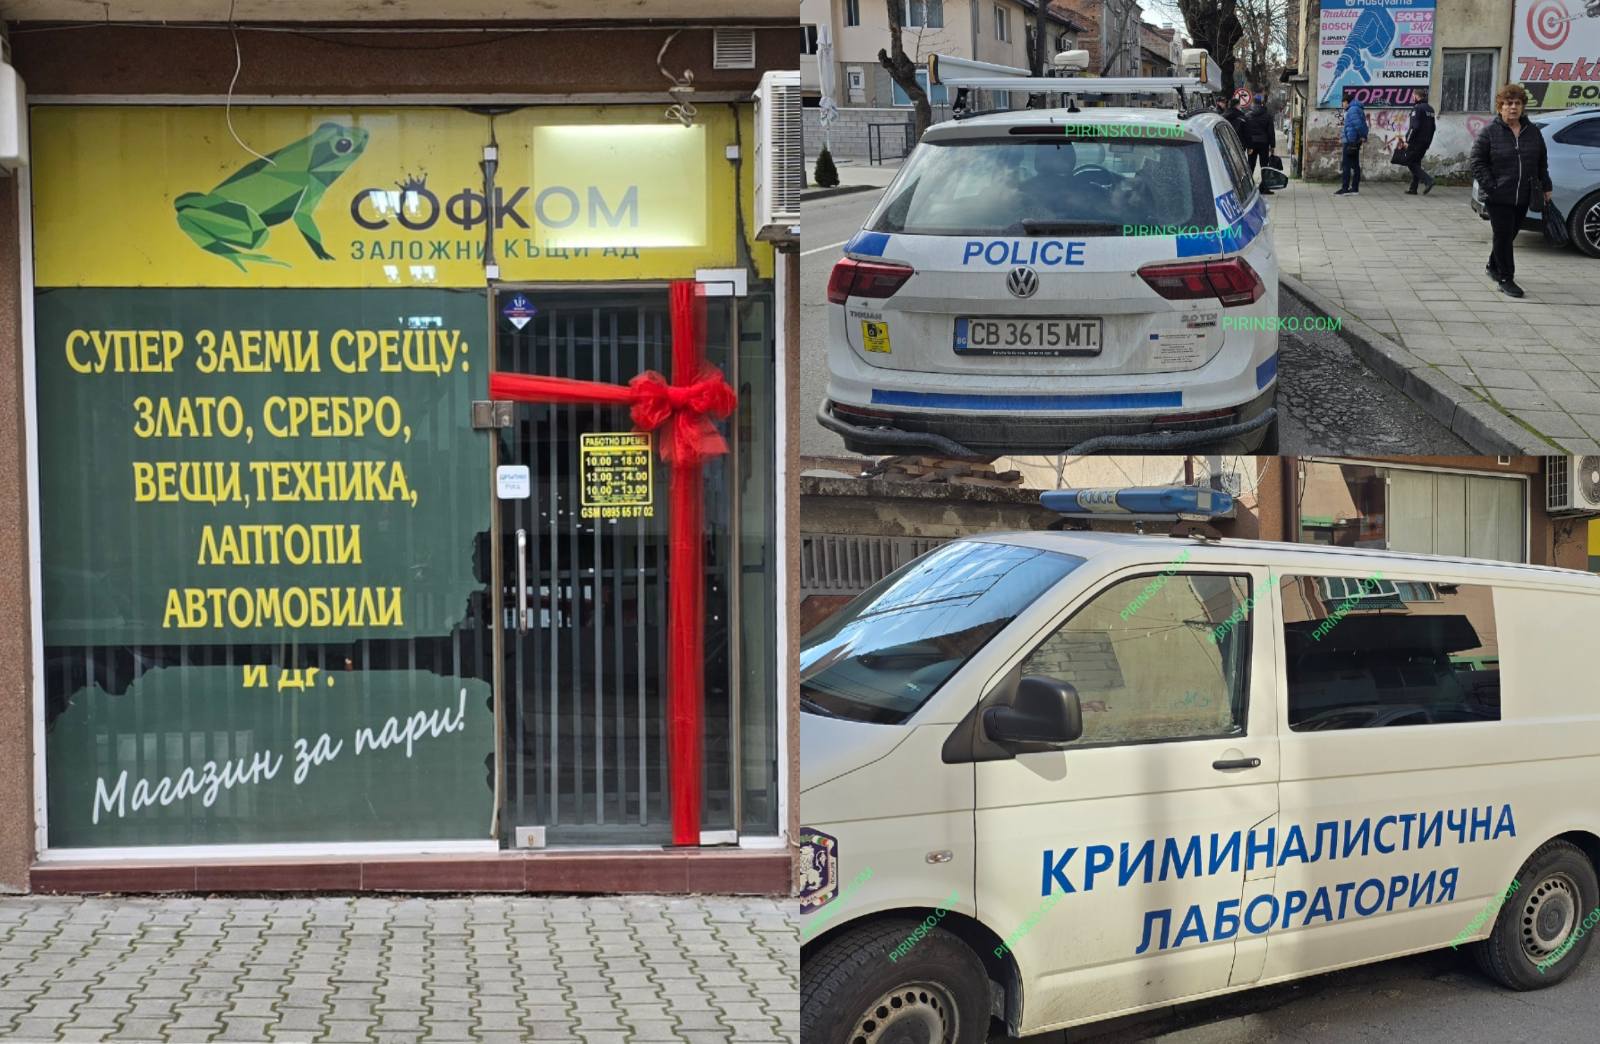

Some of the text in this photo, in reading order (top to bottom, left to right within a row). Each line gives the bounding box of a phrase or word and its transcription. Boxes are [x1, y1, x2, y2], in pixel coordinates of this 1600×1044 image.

[1321, 22, 1352, 31] BOSCH
[1382, 70, 1429, 78] KÄRCHER
[1568, 85, 1600, 99] BO
[350, 185, 639, 231] СОФКОМ
[350, 240, 487, 261] ЗАЛОЖНИ
[962, 240, 1086, 266] POLICE
[1004, 322, 1061, 346] 3615
[65, 329, 470, 377] СУПЕР ЗАЕМИ СРЕЩУ:
[133, 396, 412, 443] ЗЛАТО, СРЕБРО,
[586, 457, 612, 466] 10.00
[586, 472, 612, 482] 13.00
[622, 472, 648, 481] 14.00
[586, 485, 612, 495] 10.00
[581, 507, 601, 518] GSM
[643, 506, 654, 517] 02
[197, 524, 362, 565] ЛАПТОПИ
[162, 586, 404, 629] АВТОМОБИЛИ
[92, 687, 467, 825] Магазин за пари!
[1041, 804, 1517, 896] КРИМИНАЛИСТИЧНА
[1135, 867, 1460, 954] ЛАБОРАТОРИЯ
